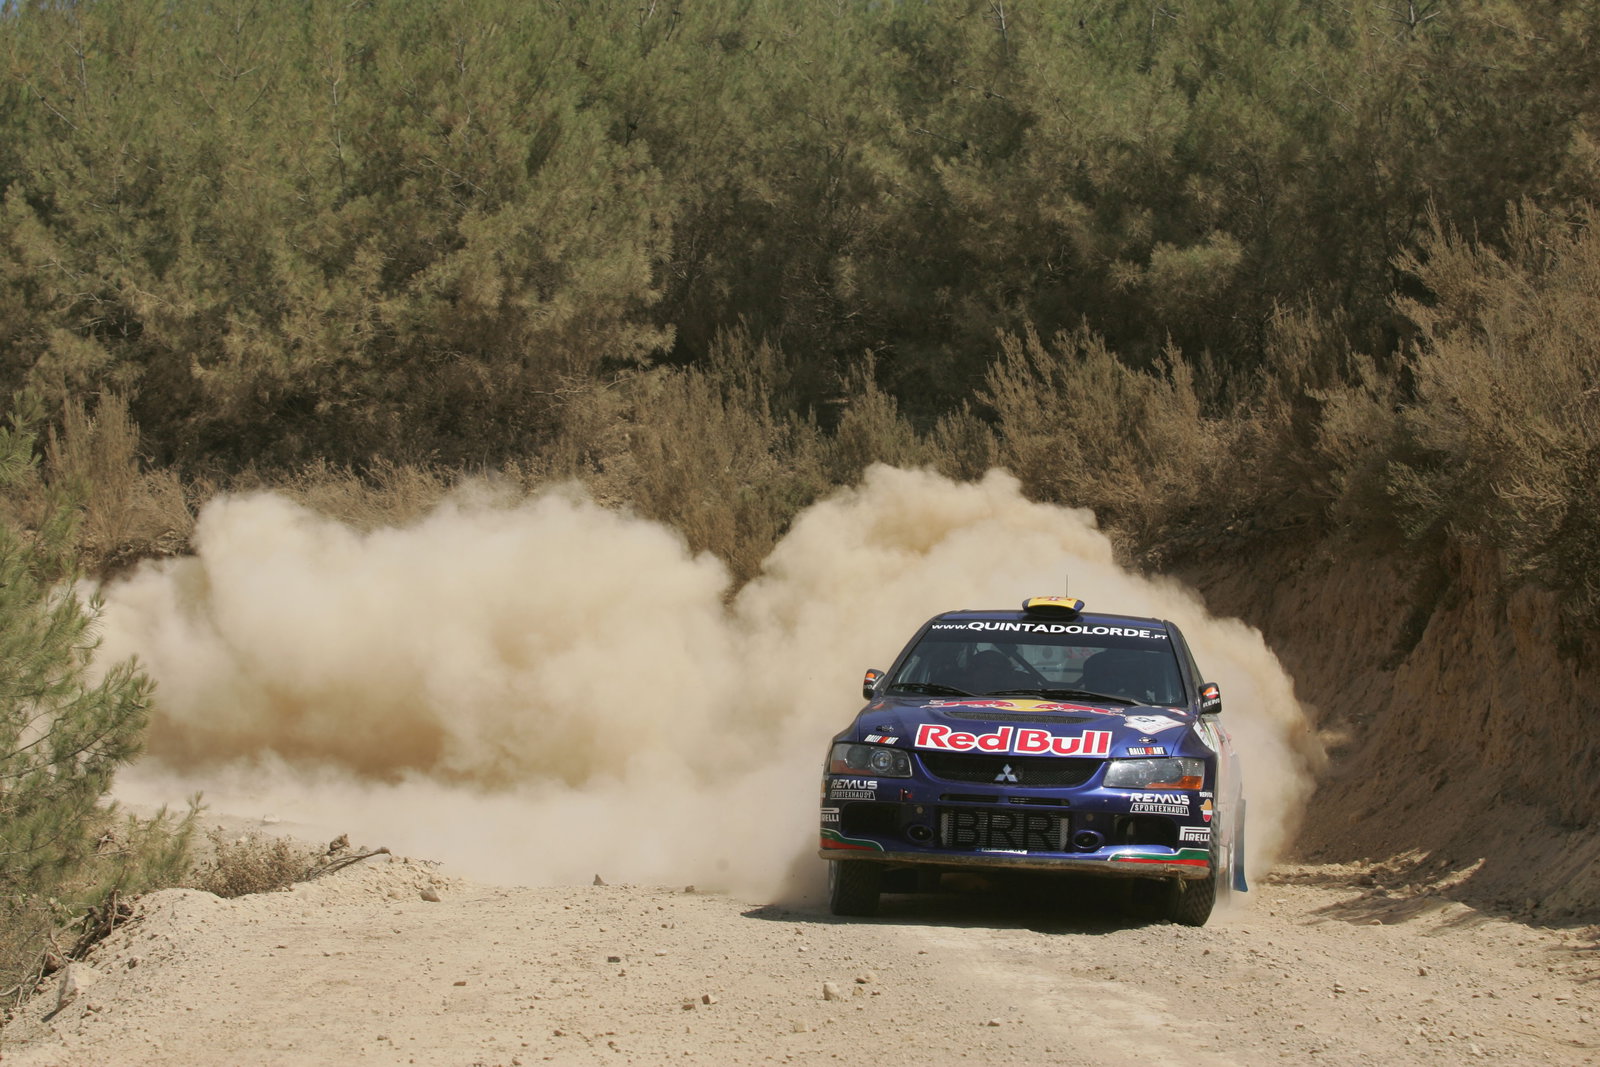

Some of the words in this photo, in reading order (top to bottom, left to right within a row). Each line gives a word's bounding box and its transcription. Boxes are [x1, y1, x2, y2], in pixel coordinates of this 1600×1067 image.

[916, 724, 1013, 752] Red
[1015, 728, 1112, 757] Bull
[831, 779, 878, 790] REMUS
[1130, 793, 1190, 805] REMUS
[1134, 804, 1187, 813] SPORTEXHAUST
[952, 811, 1054, 851] BRR
